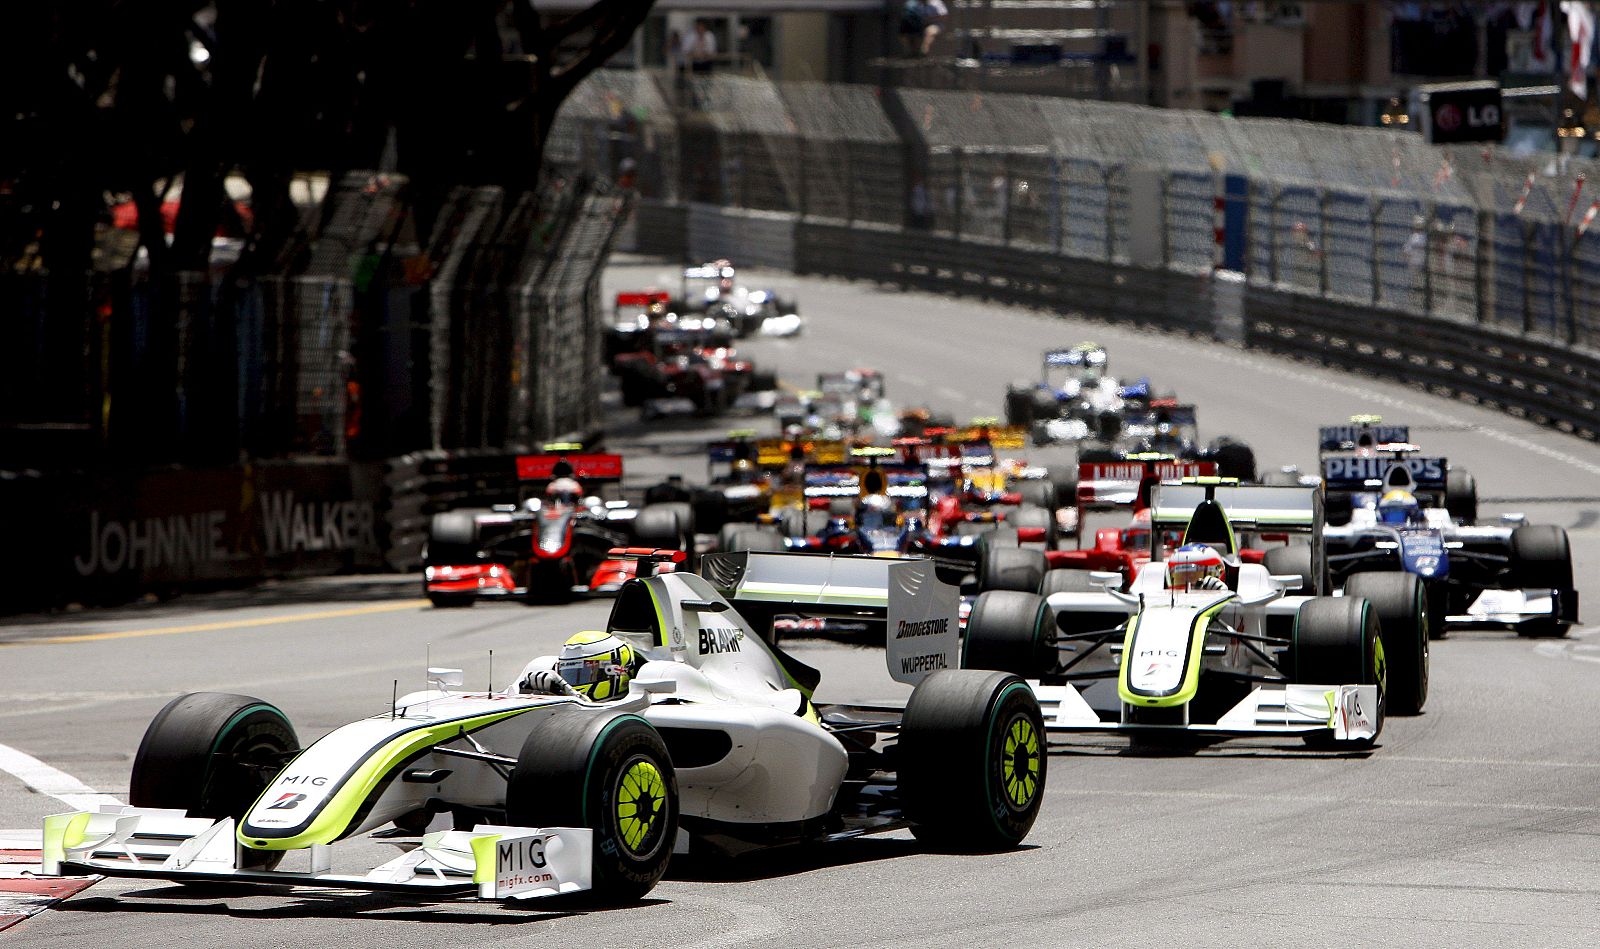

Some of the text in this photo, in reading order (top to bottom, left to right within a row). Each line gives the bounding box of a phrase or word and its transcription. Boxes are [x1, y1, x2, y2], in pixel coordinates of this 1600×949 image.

[1468, 104, 1498, 127] LG
[1326, 459, 1442, 478] PHIPS
[74, 489, 376, 576] JOHNNIE WALKER
[896, 618, 949, 639] BRIDGESTONE
[901, 652, 947, 674] WUPPERTAL
[280, 775, 328, 786] MIG
[499, 839, 547, 873] MIG
[499, 873, 552, 888] migfx.com
